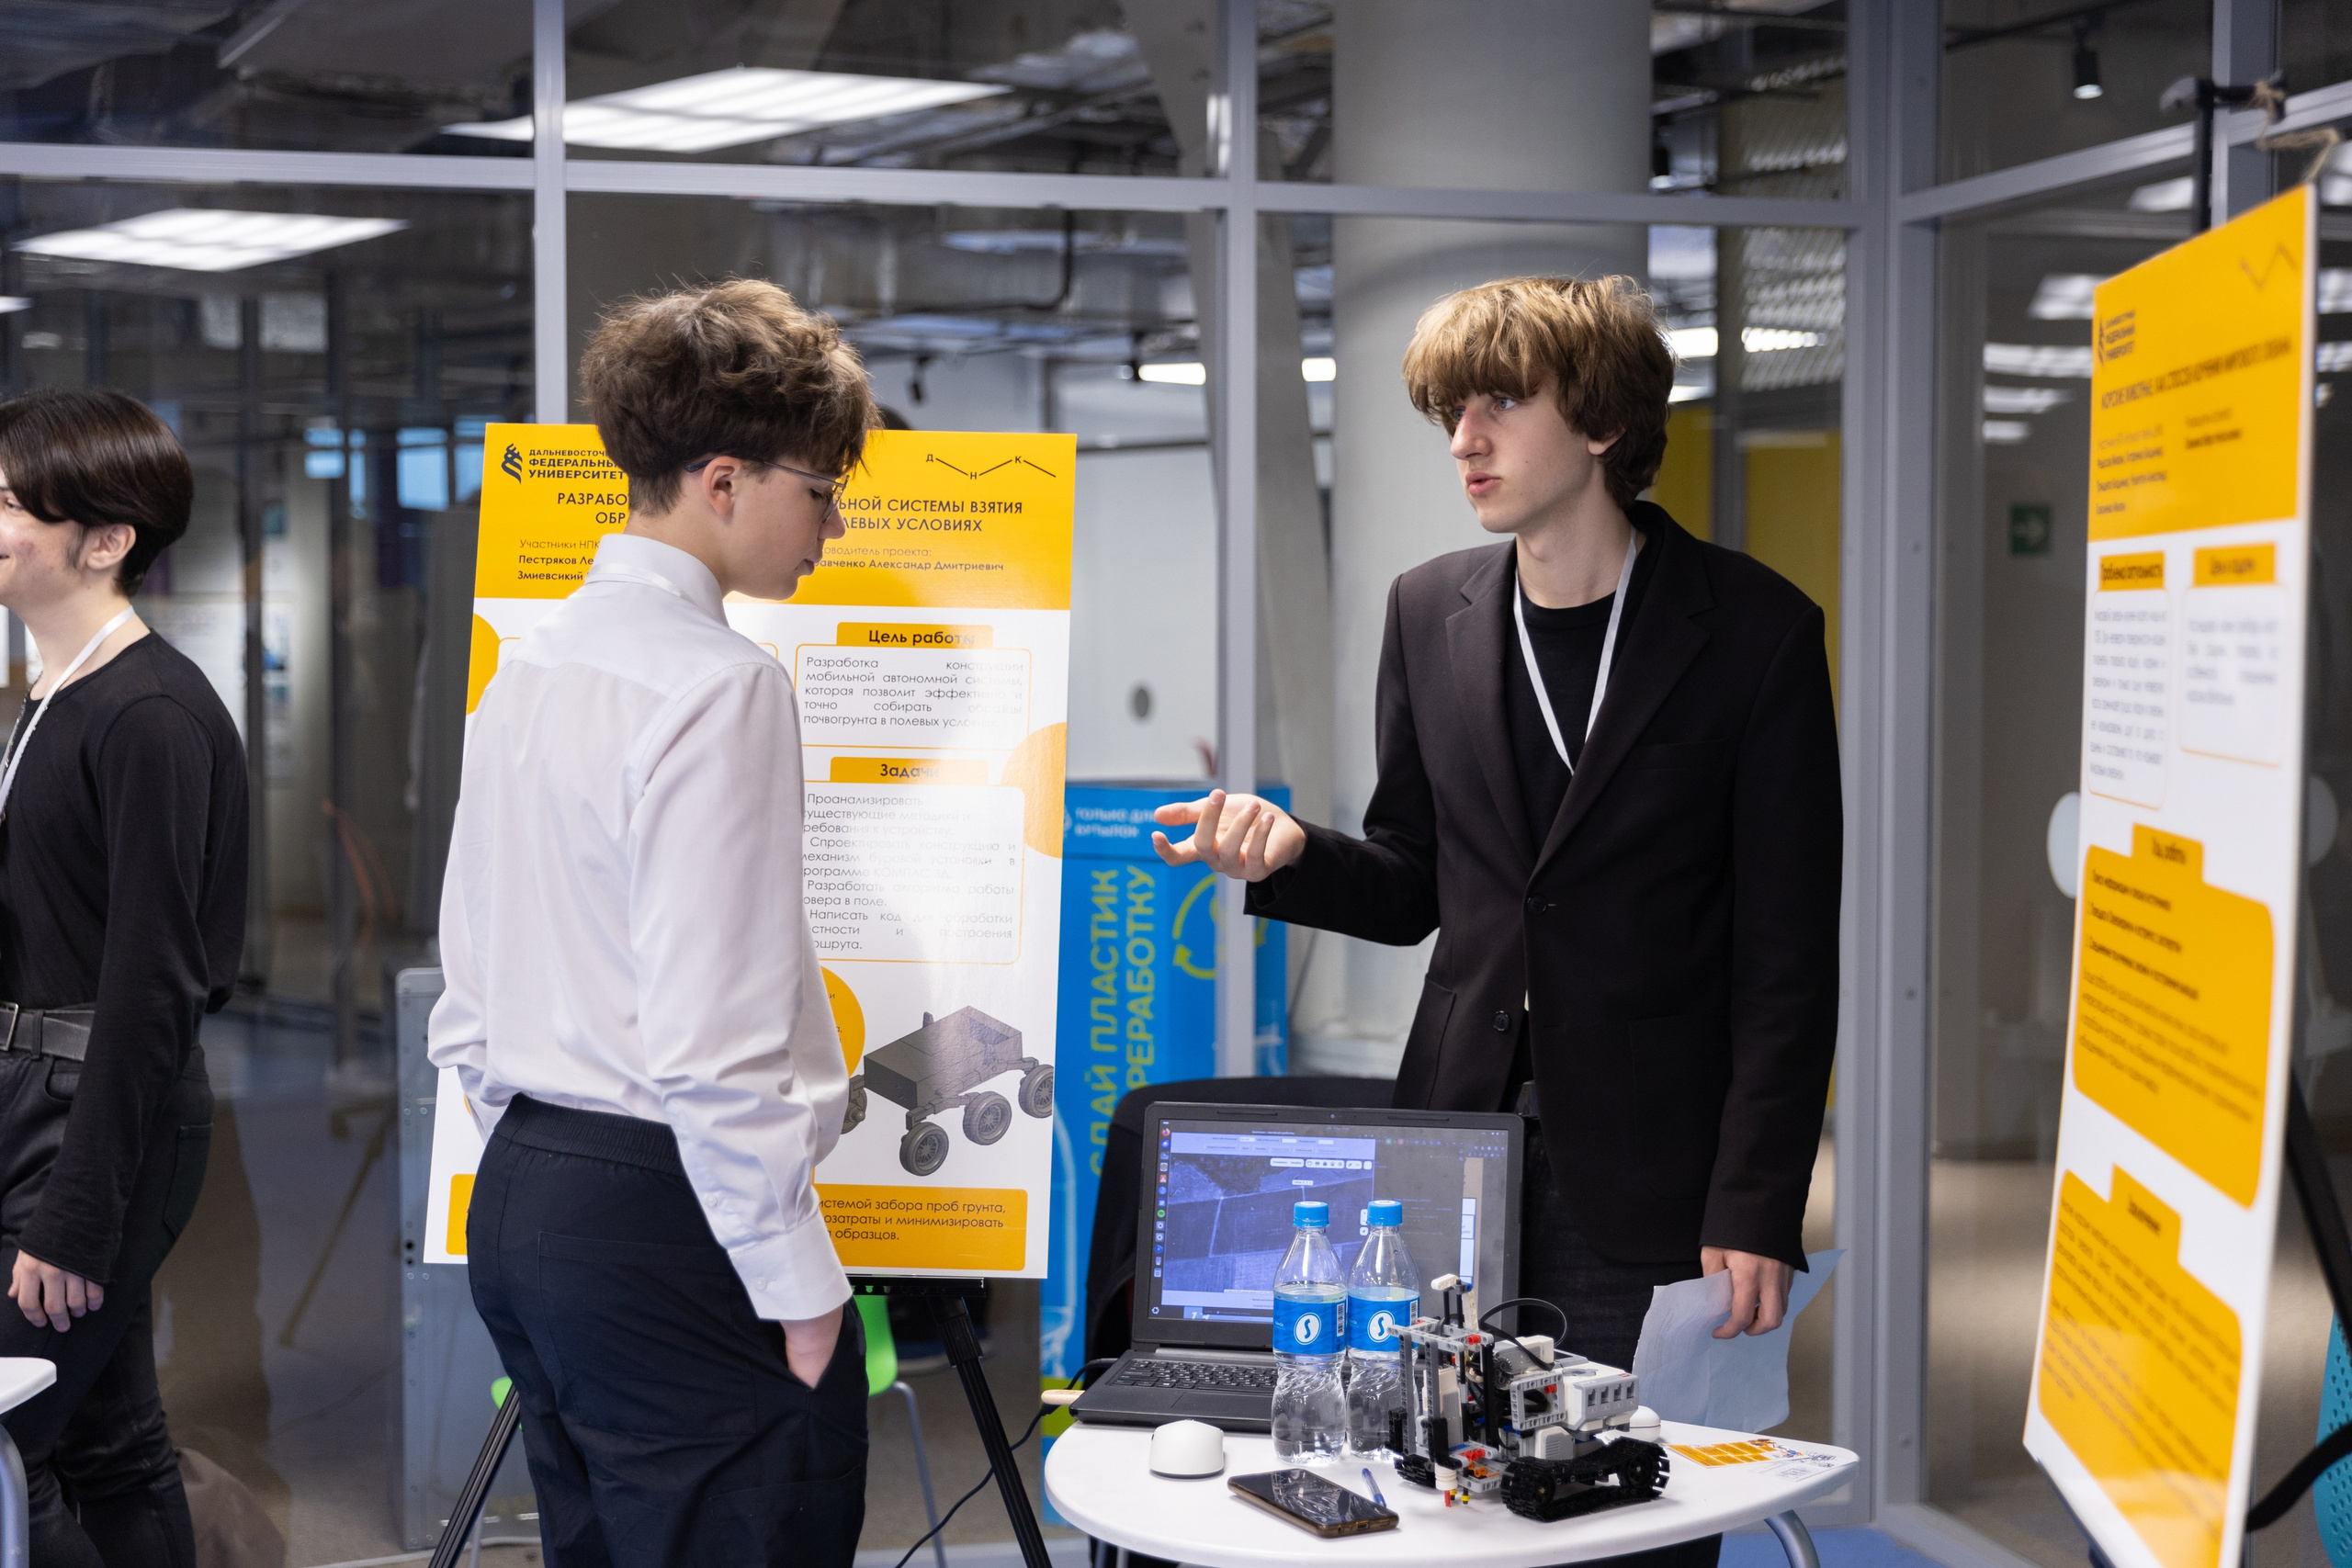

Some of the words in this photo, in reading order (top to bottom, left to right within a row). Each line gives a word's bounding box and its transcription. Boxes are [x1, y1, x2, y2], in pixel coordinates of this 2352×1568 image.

[926, 454, 933, 462] Д
[1014, 456, 1022, 464] К
[528, 469, 625, 479] УНИВЕРСИТЕТ
[558, 492, 628, 505] РАЗРАБО
[888, 499, 965, 513] СИСТЕМЫ
[971, 501, 1023, 514] ВЗЯТИЯ
[595, 512, 626, 524] ОБР
[897, 518, 983, 532] УСЛОВИЯХ
[519, 539, 577, 549] Участники
[883, 547, 933, 558] проекта:
[518, 555, 577, 566] Пестряков
[868, 559, 932, 571] Александр
[934, 561, 1004, 571] Дмитриевич
[517, 571, 583, 581] Змиевсикий
[868, 629, 908, 645] Цель
[912, 631, 976, 646] работы
[807, 657, 879, 670] Разработка
[946, 660, 1023, 672] конструкции
[806, 671, 875, 682] мобильной
[882, 673, 957, 684] автономной
[805, 686, 854, 697] которая
[863, 688, 915, 698] позволит
[925, 688, 1006, 700] эффективно
[805, 701, 838, 710] точно
[874, 701, 933, 713] собирать
[804, 716, 877, 727] почвогрунта
[881, 716, 887, 726] в
[889, 716, 939, 728] полевых
[880, 764, 939, 778] Задачи
[807, 794, 923, 807] Проанализировать
[805, 809, 897, 821] уществующие
[899, 811, 959, 822] методики
[809, 837, 911, 851] Спроектировать
[920, 840, 1000, 853] конструкцию
[1008, 843, 1015, 852] и
[804, 867, 870, 878] рограмме
[808, 880, 885, 893] Разработать
[967, 884, 1014, 897] работы
[803, 897, 841, 908] овера
[844, 897, 851, 906] в
[854, 897, 888, 907] поле.
[809, 909, 868, 920] Написать
[880, 913, 901, 923] код
[944, 912, 1012, 925] обработки
[811, 926, 860, 935] стности
[940, 928, 1012, 939] построения
[1091, 869, 1119, 1052] ПЛАСТИК
[875, 1199, 923, 1212] забора
[926, 1200, 959, 1213] проб
[962, 1202, 1006, 1214] грунта,
[824, 1214, 881, 1226] озатраты
[897, 1216, 1004, 1229] минимизировать
[835, 1228, 899, 1241] образцов.
